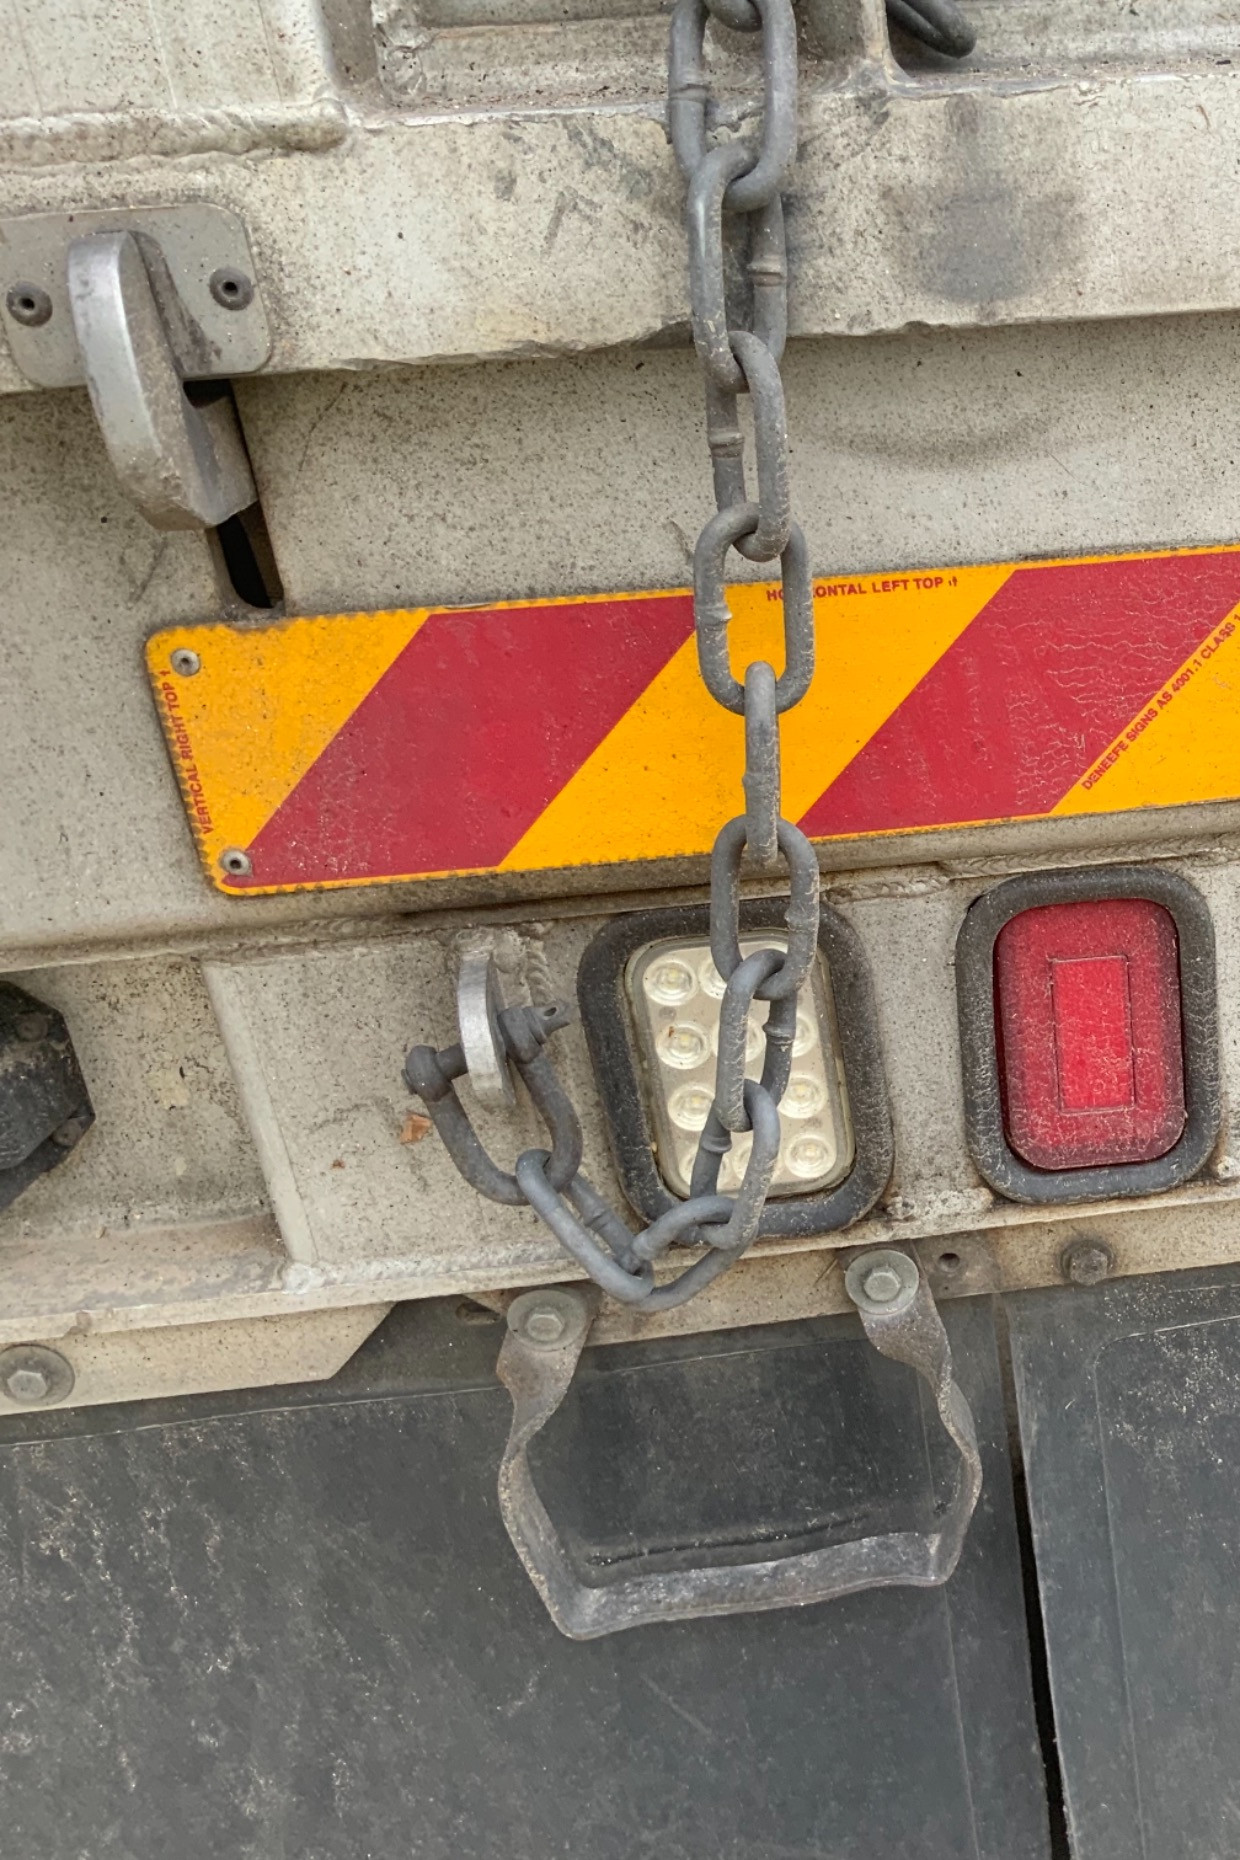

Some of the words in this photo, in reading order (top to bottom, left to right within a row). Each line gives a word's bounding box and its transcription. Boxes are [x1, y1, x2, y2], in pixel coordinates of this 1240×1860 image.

[766, 583, 867, 601] HONTAL
[872, 579, 909, 593] LEFT
[914, 576, 943, 590] TOP
[162, 682, 180, 711] TOP
[1081, 740, 1129, 790] DENEEFE
[1126, 707, 1158, 742] SIGNS
[1156, 691, 1173, 710] AS
[1171, 658, 1203, 692] 4001.1
[1200, 622, 1236, 660] CLASS
[170, 715, 194, 761] RIGHT
[185, 763, 214, 835] VERTICAL
